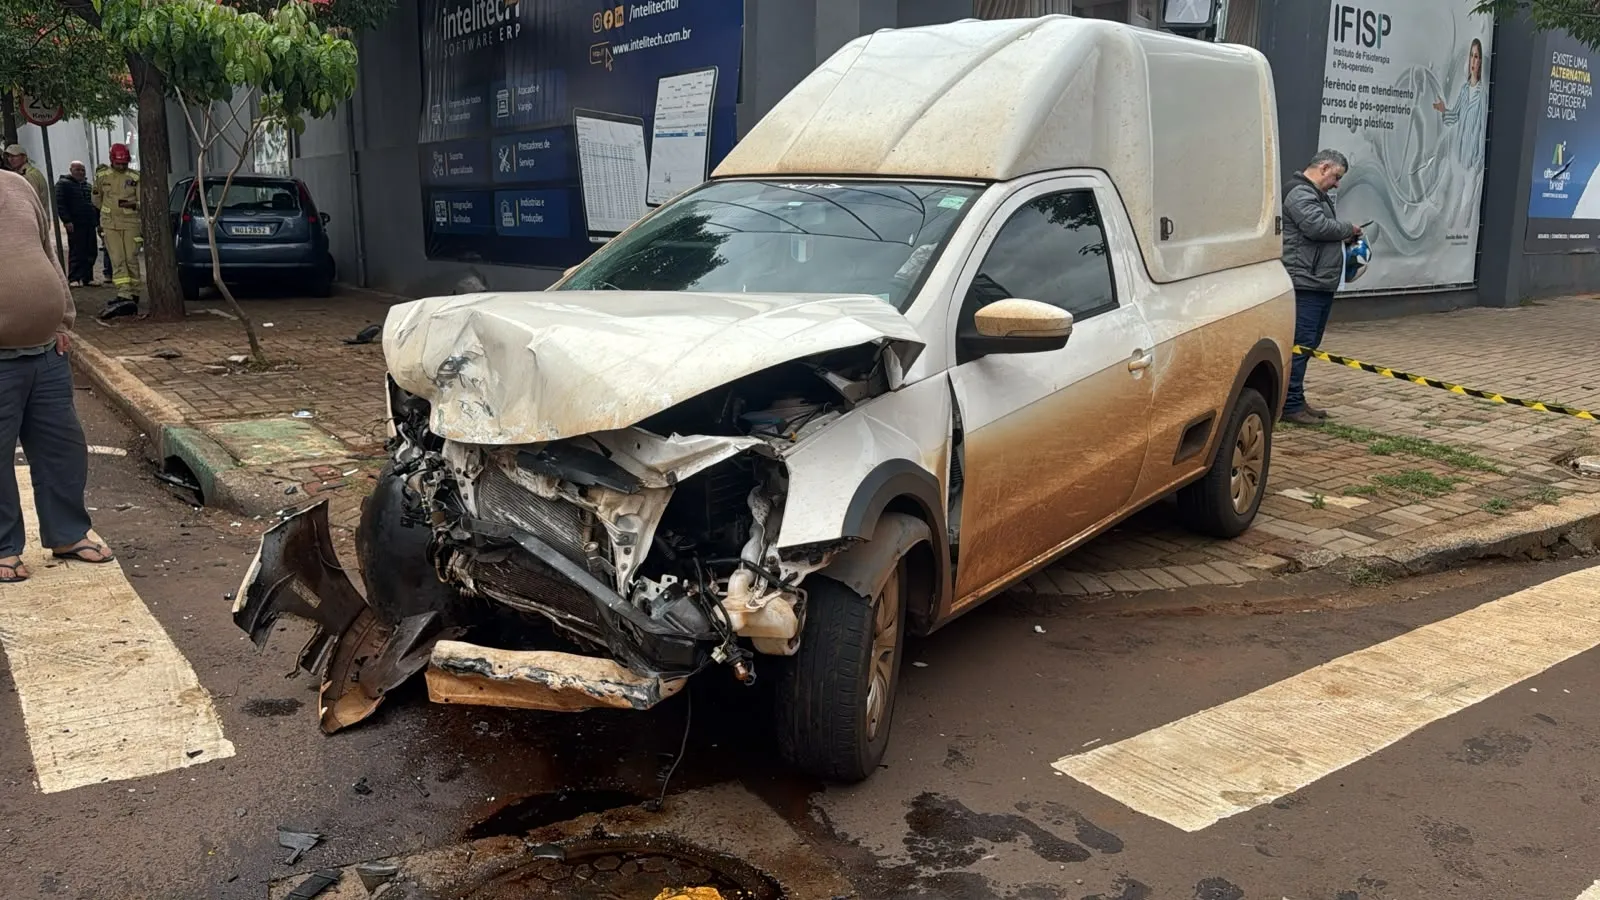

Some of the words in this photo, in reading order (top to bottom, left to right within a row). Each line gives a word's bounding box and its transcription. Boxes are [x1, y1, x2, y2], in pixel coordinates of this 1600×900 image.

[1334, 3, 1391, 49] IFISP
[444, 31, 492, 58] SOFTWARE
[500, 23, 520, 41] ERP
[612, 27, 691, 55] www.intelitech.com.br
[1333, 46, 1354, 58] Instituto
[1356, 50, 1361, 59] de
[1363, 51, 1390, 65] Fisioterapia
[1552, 51, 1573, 67] EXISTE
[1574, 57, 1587, 70] UMA
[1337, 59, 1374, 74] Pós-operatório
[1551, 65, 1591, 84] ALTERNATIVA
[1358, 84, 1369, 93] em
[1371, 85, 1413, 99] atendimento
[1550, 79, 1576, 94] MELHOR
[1577, 84, 1593, 97] PARA
[1322, 96, 1346, 108] cursos
[1349, 97, 1358, 109] de
[1360, 99, 1411, 115] pós-operatório
[1548, 92, 1581, 108] PROTEGER
[1582, 98, 1586, 109] A
[1329, 112, 1362, 128] cirurgias
[1364, 116, 1394, 130] plásticas
[1547, 105, 1560, 119] SUA
